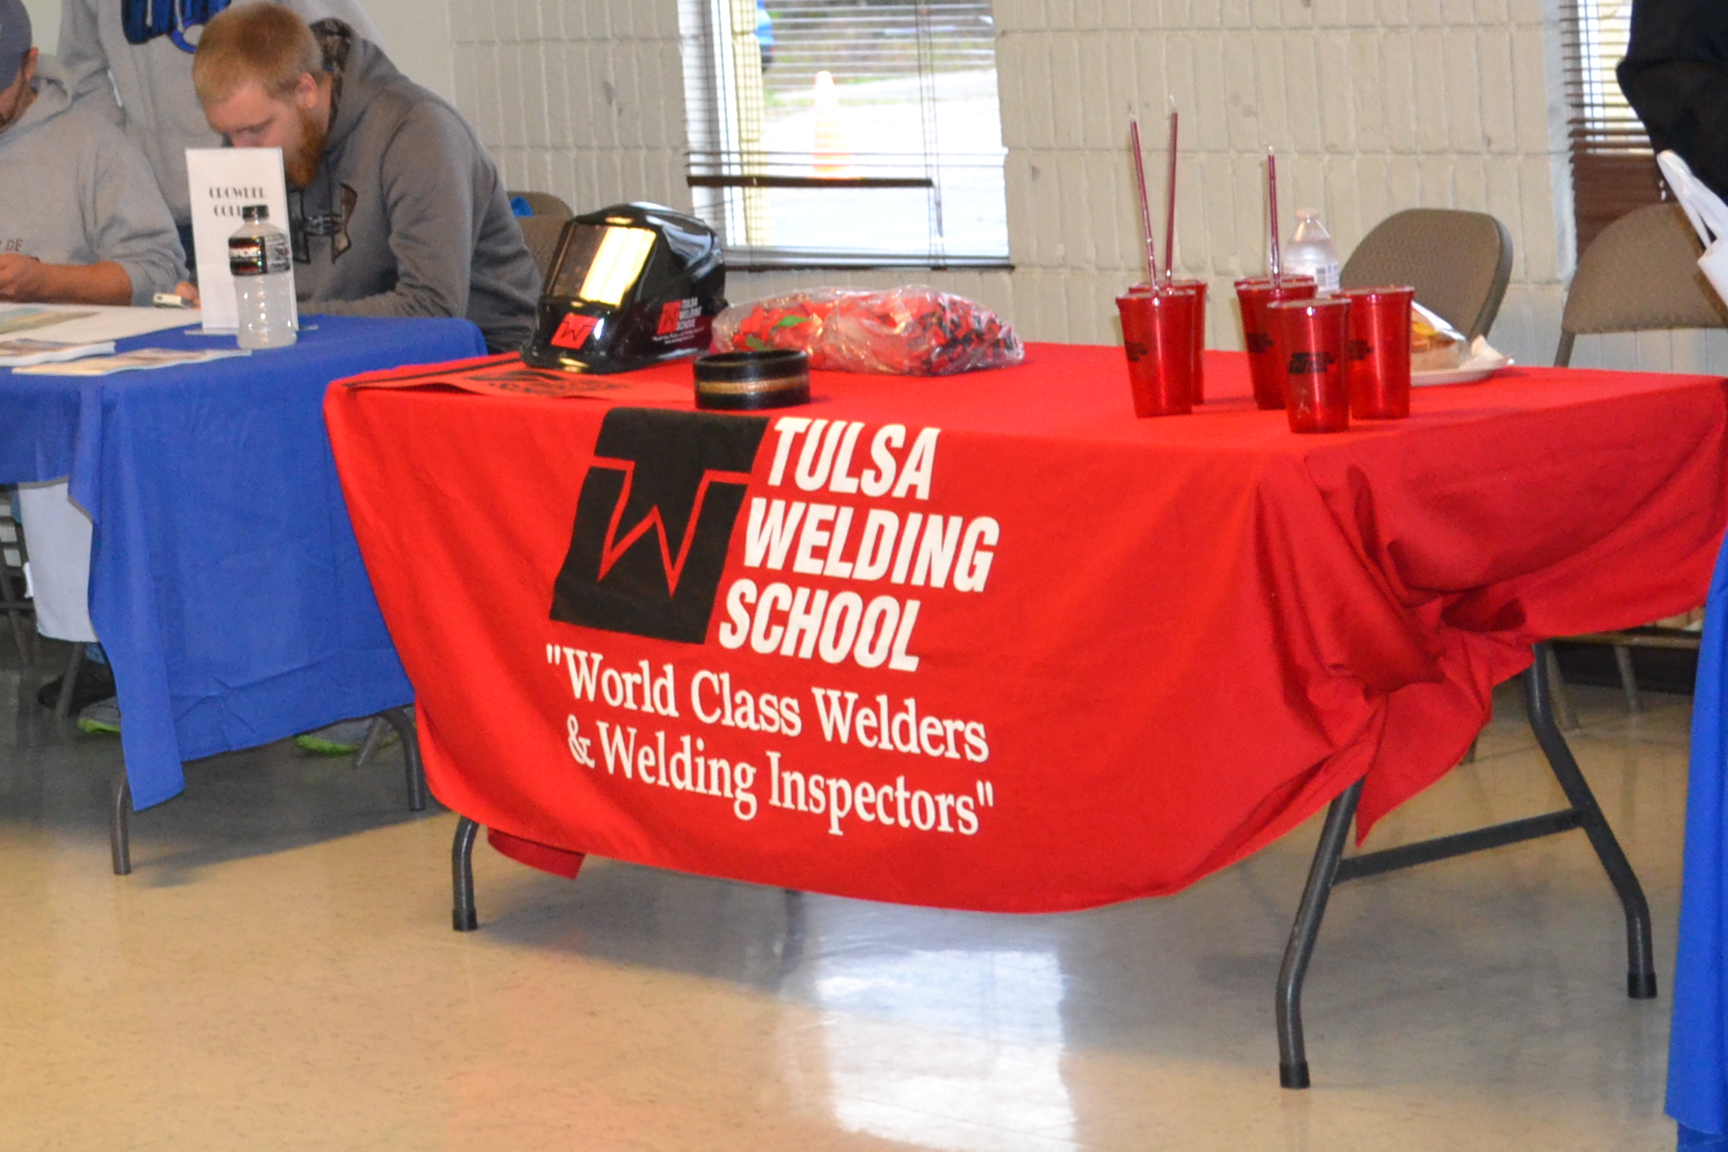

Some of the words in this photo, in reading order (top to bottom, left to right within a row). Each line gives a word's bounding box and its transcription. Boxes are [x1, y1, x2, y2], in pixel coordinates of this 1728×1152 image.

[213, 204, 242, 217] COLL
[768, 416, 941, 500] TULSA
[745, 497, 1000, 592] WELDING
[718, 578, 921, 672] SCHOOL
[545, 643, 679, 718] "World
[690, 670, 803, 737] Class
[811, 686, 990, 763] Welders
[566, 713, 596, 769] &
[596, 720, 758, 821] Welding
[766, 750, 994, 835] Inspectors"
